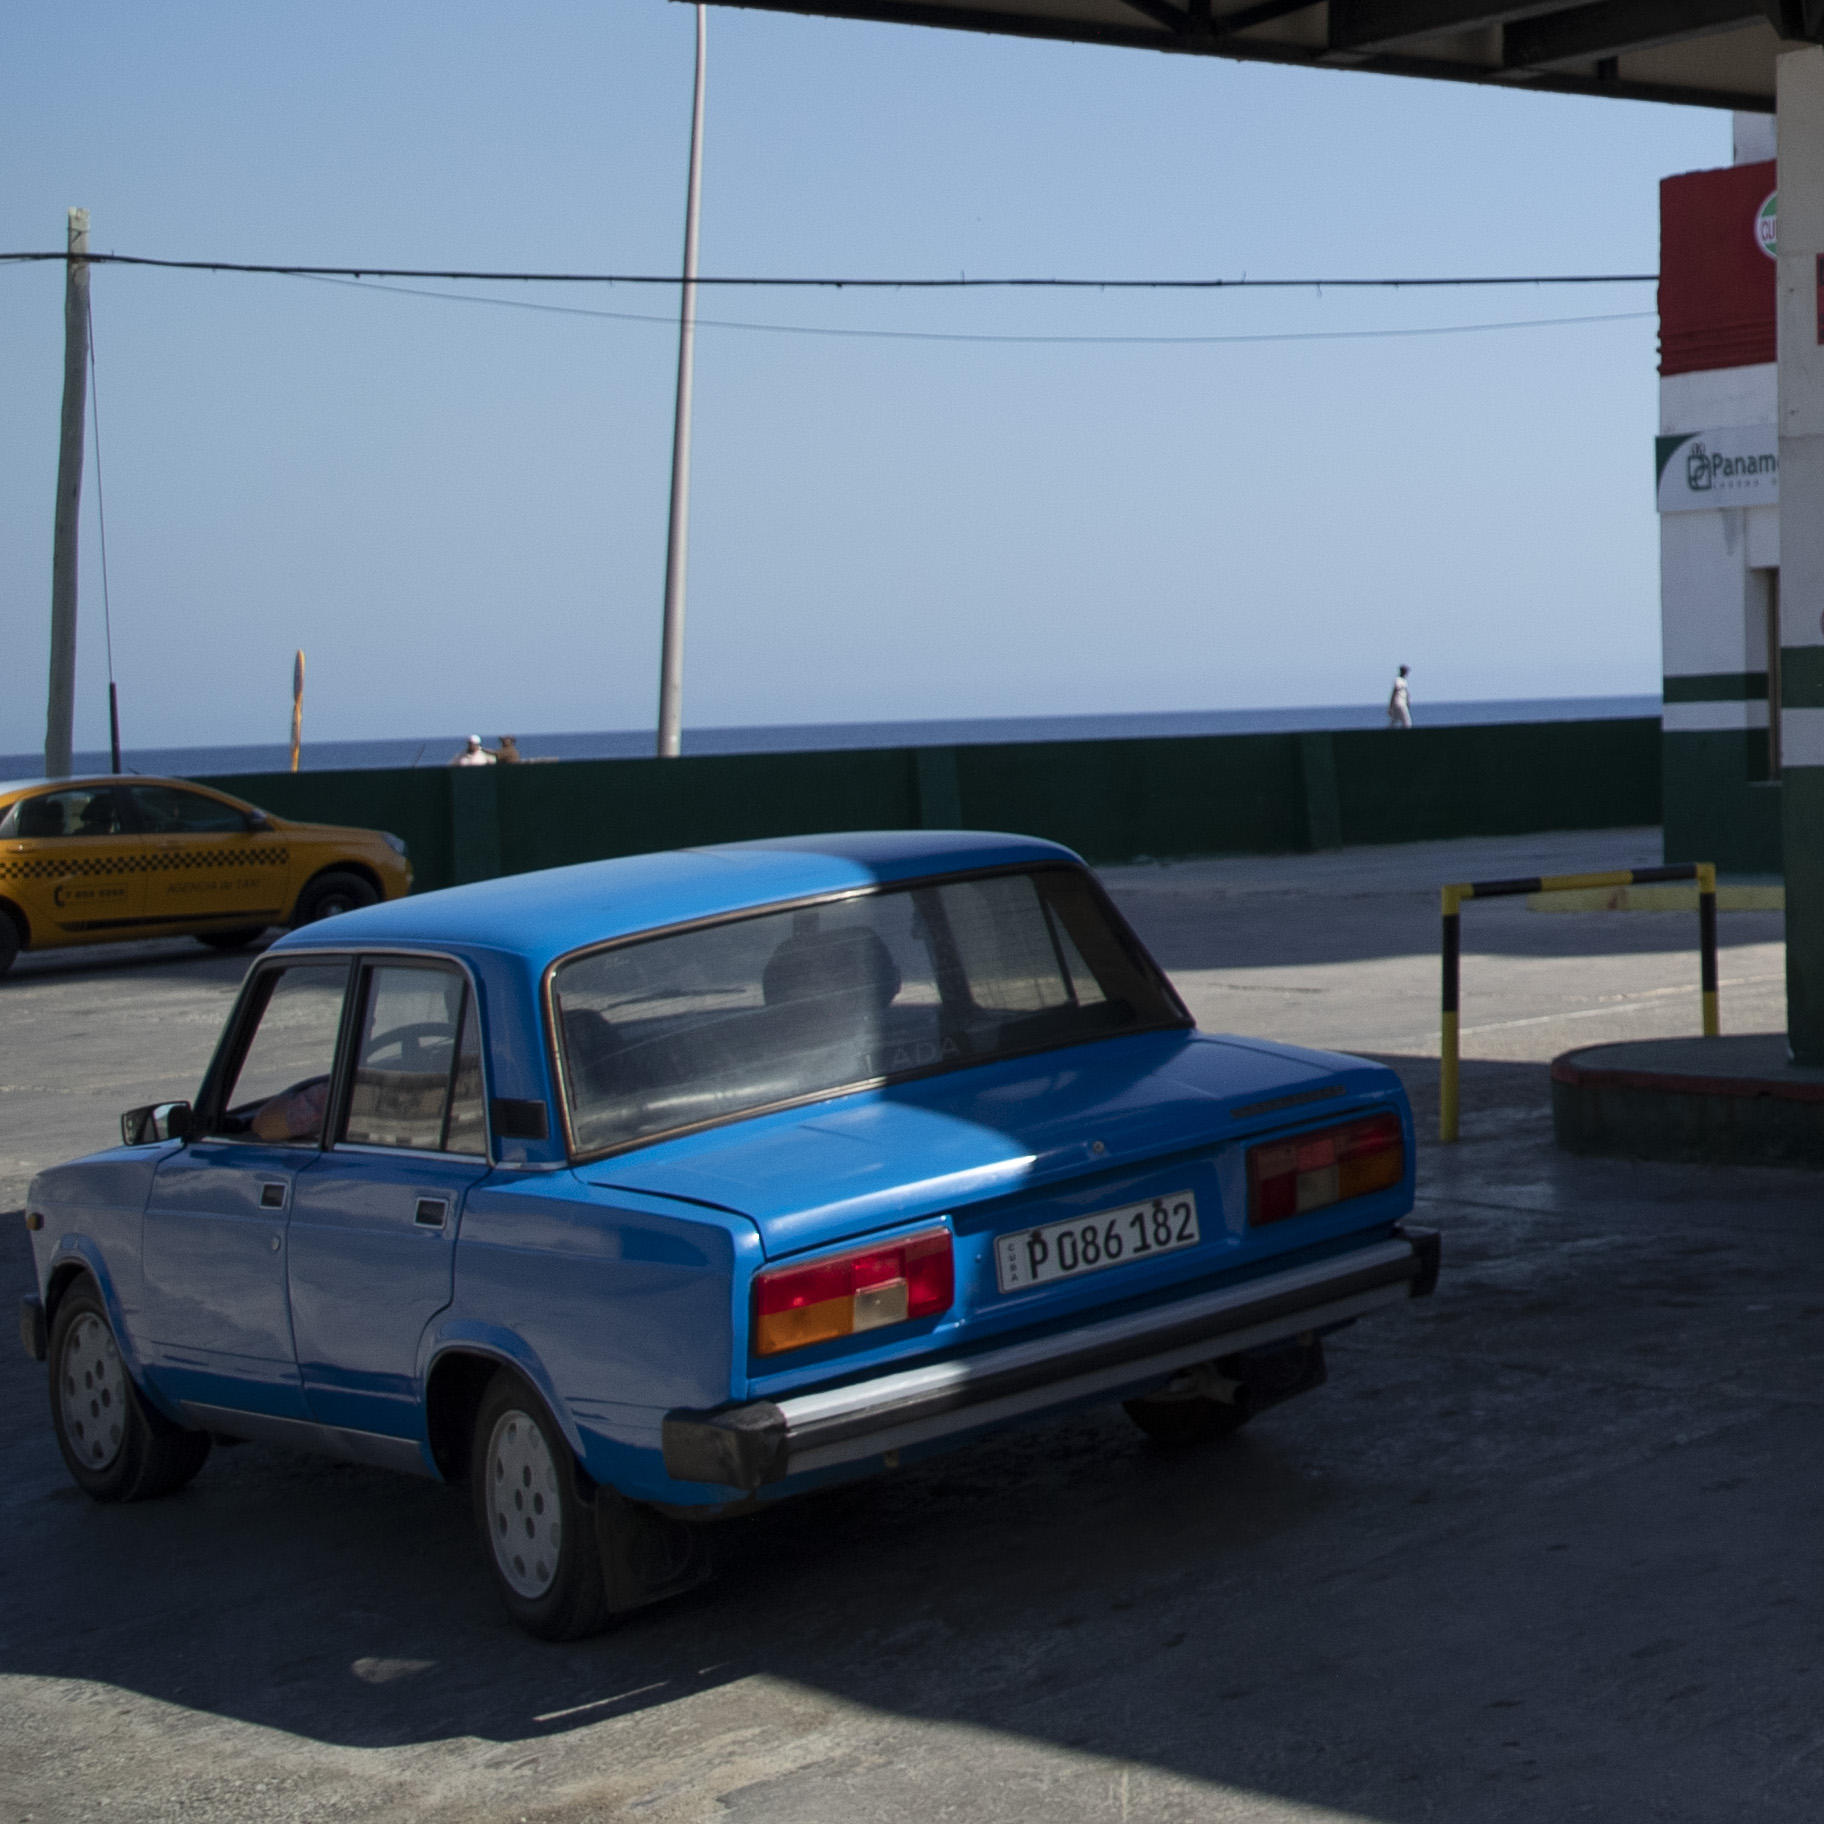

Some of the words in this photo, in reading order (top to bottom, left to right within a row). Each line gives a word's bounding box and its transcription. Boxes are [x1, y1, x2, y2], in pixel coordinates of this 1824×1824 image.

[1761, 219, 1776, 241] CU
[1711, 452, 1779, 478] Panam
[1007, 1244, 1019, 1282] CUBA
